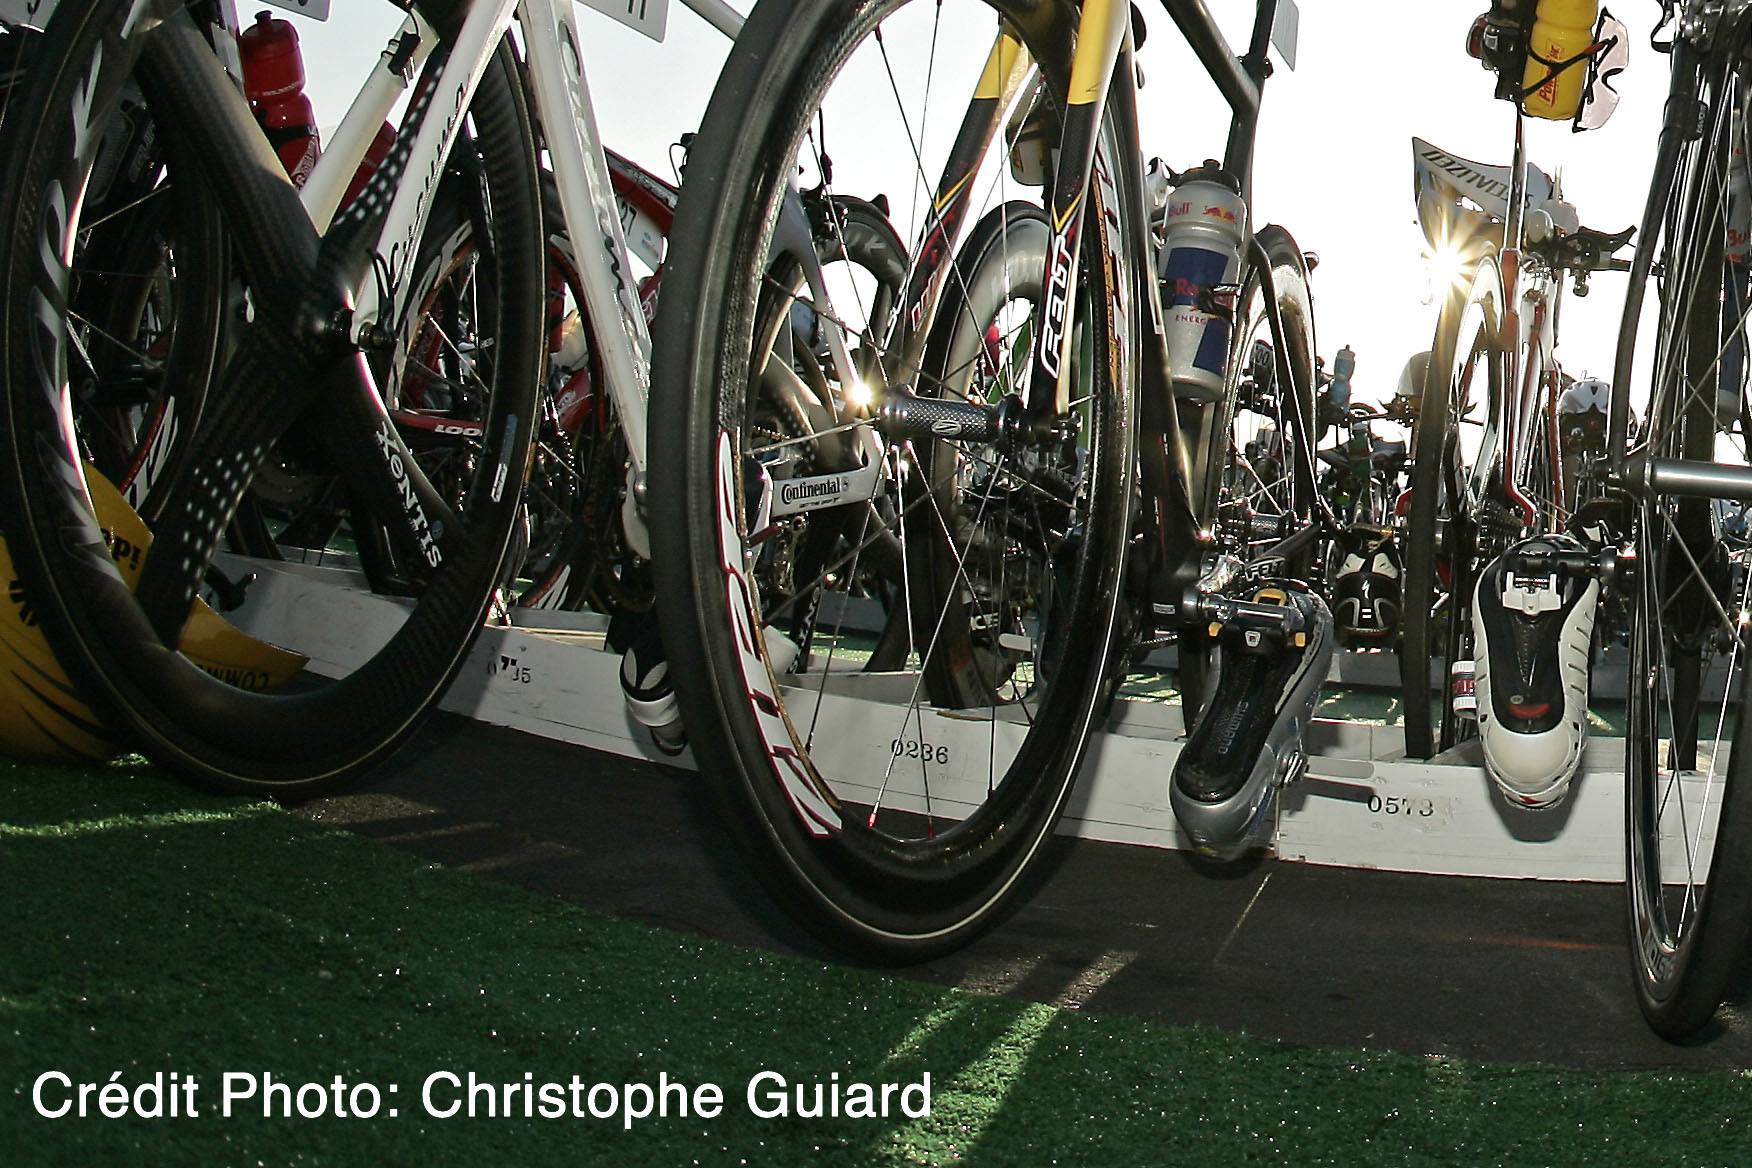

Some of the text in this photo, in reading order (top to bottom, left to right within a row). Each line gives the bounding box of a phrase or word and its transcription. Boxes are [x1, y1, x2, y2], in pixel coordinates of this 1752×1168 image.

[1421, 150, 1535, 209] SECIALIZED
[1040, 234, 1073, 379] FELT
[780, 477, 841, 505] Continental
[890, 738, 950, 766] 0236
[1366, 795, 1435, 818] 0573
